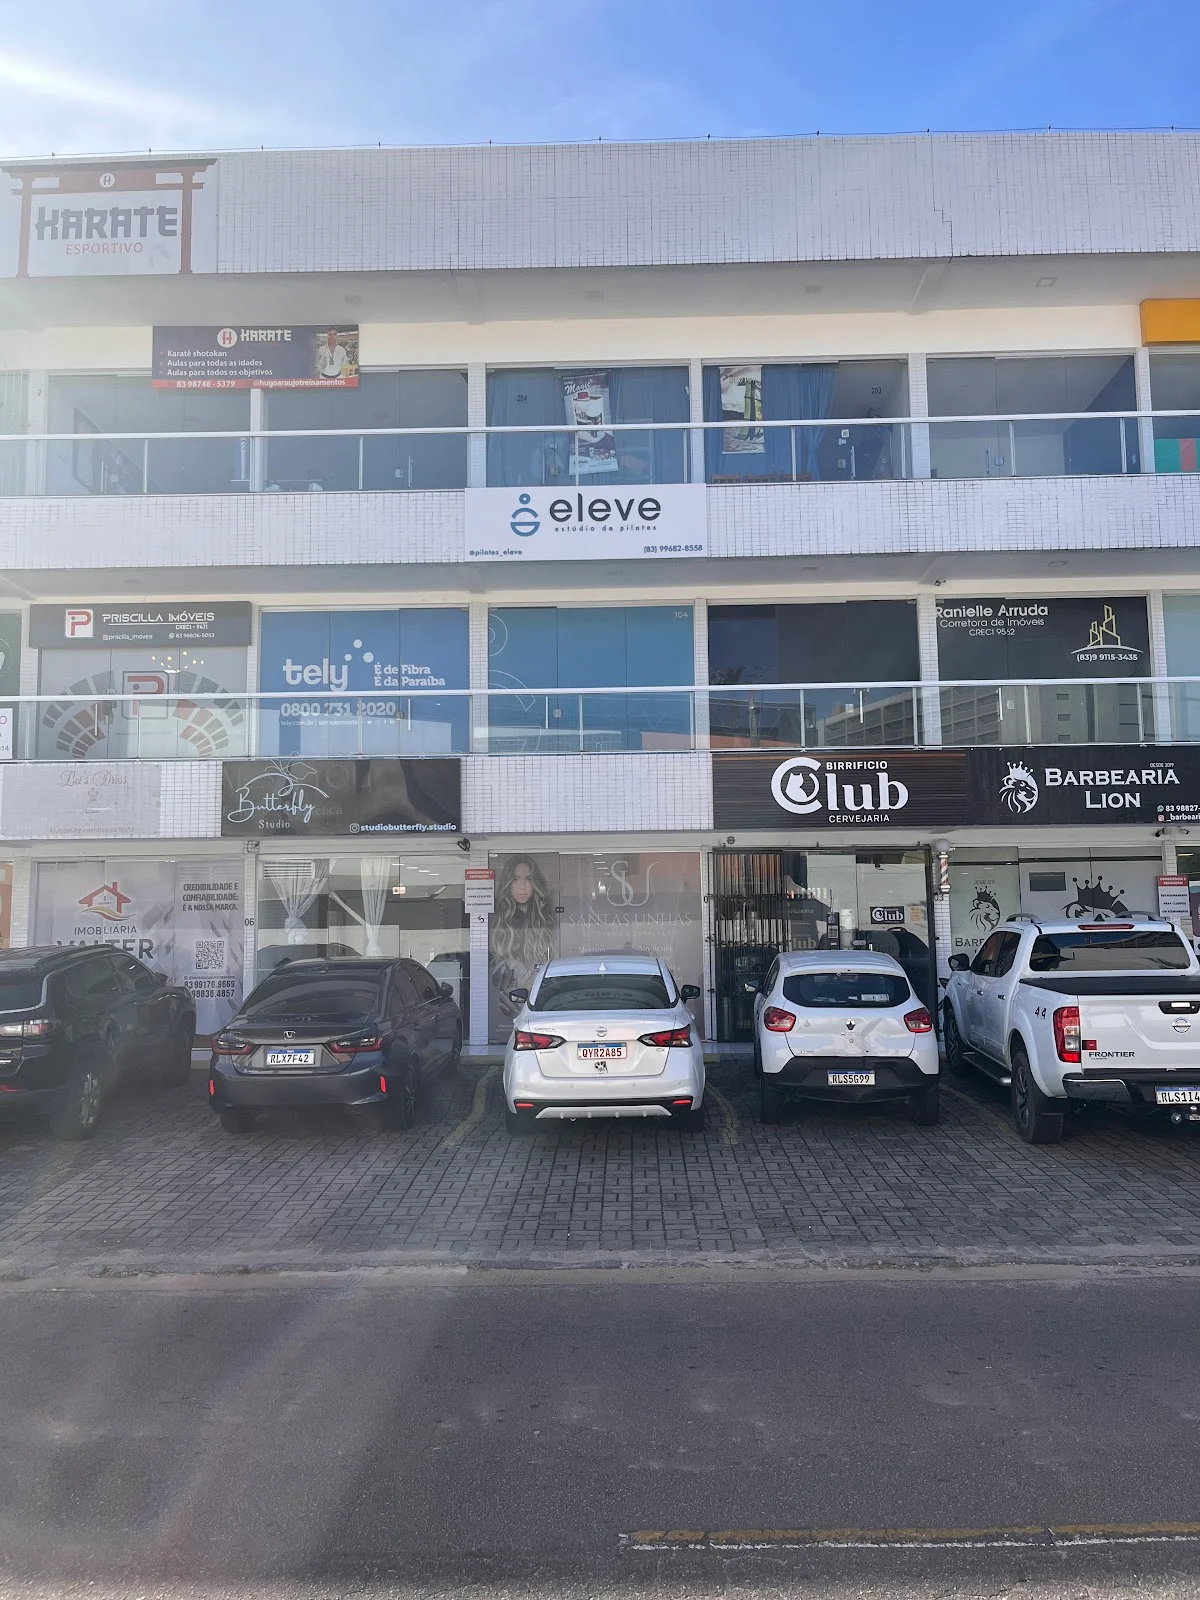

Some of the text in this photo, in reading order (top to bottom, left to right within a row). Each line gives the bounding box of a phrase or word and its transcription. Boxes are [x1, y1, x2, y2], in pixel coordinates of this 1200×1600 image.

[66, 243, 143, 255] ESPORTIVO
[189, 361, 205, 369] para
[189, 370, 205, 378] para
[240, 369, 273, 378] objetivos
[217, 379, 236, 387] 5379
[549, 493, 661, 522] eleve
[659, 545, 703, 553] 99682-8558
[936, 603, 1049, 618] Ranielle Arruda
[102, 611, 215, 622] PRISCILLA IMÓVEIS
[940, 616, 1045, 628] Corretora de Imóveis
[969, 628, 994, 636] CRECI
[1076, 653, 1138, 661] (83)9 9115-3435
[374, 662, 431, 675] É de Fibra
[283, 658, 348, 691] tely
[374, 674, 446, 686] É da Paraíba
[281, 702, 397, 717] 0800 731 2020
[826, 761, 888, 770] BIRRIFICIO
[1045, 768, 1180, 786] BARBEARIA
[771, 757, 909, 814] Club
[227, 786, 316, 823] Butterfly
[1085, 790, 1141, 809] LION
[1165, 804, 1175, 812] 83
[828, 815, 890, 823] CERVEJARIA
[258, 820, 291, 829] Studio
[360, 822, 457, 833] studiobutterfly.studio
[183, 883, 232, 892] CREDIBILIDADE
[872, 907, 903, 921] Club
[244, 918, 255, 927] 06
[568, 912, 692, 927] SANTAS UNHAS
[74, 925, 137, 935] IMOBLIÁRIA
[582, 1048, 622, 1058] QYR2A85
[270, 1054, 309, 1063] RLX7F42
[832, 1075, 870, 1083] RLS5G99
